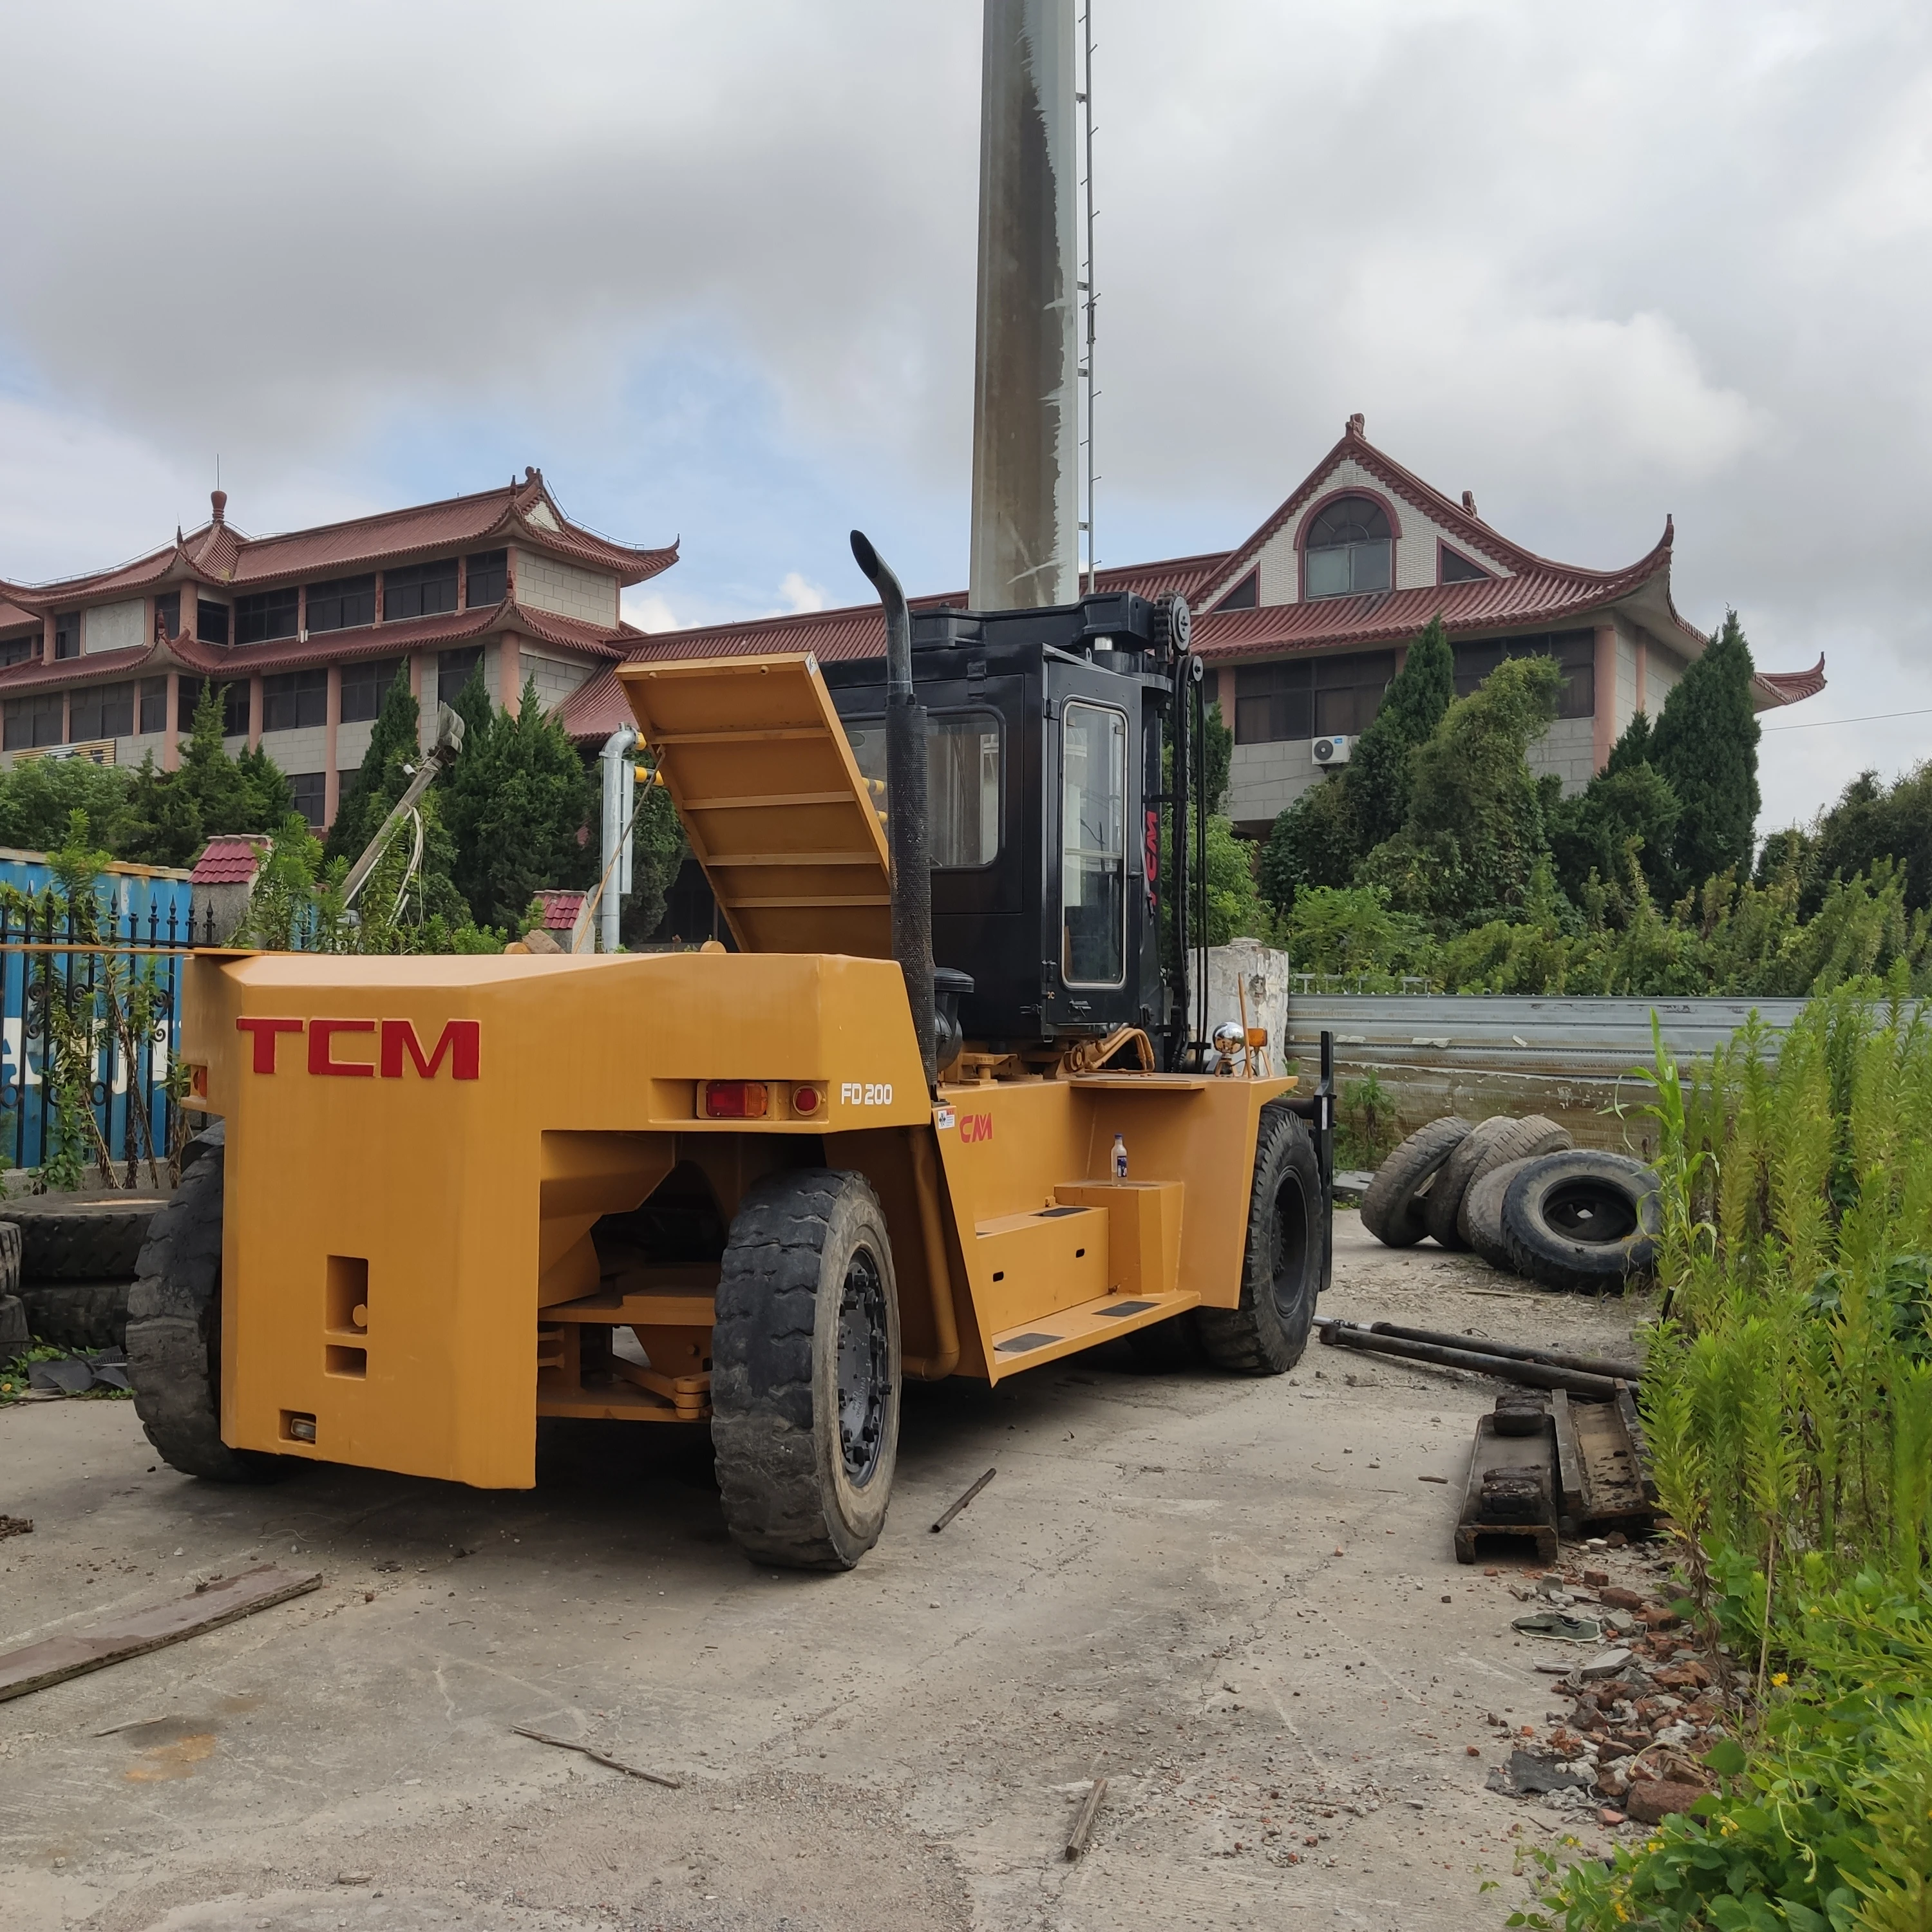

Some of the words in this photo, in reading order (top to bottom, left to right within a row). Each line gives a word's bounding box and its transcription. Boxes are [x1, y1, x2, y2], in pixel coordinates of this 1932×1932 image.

[236, 1016, 480, 1080] TCM
[841, 1083, 862, 1104] FD
[864, 1083, 893, 1104] 200
[959, 1112, 992, 1143] CM
